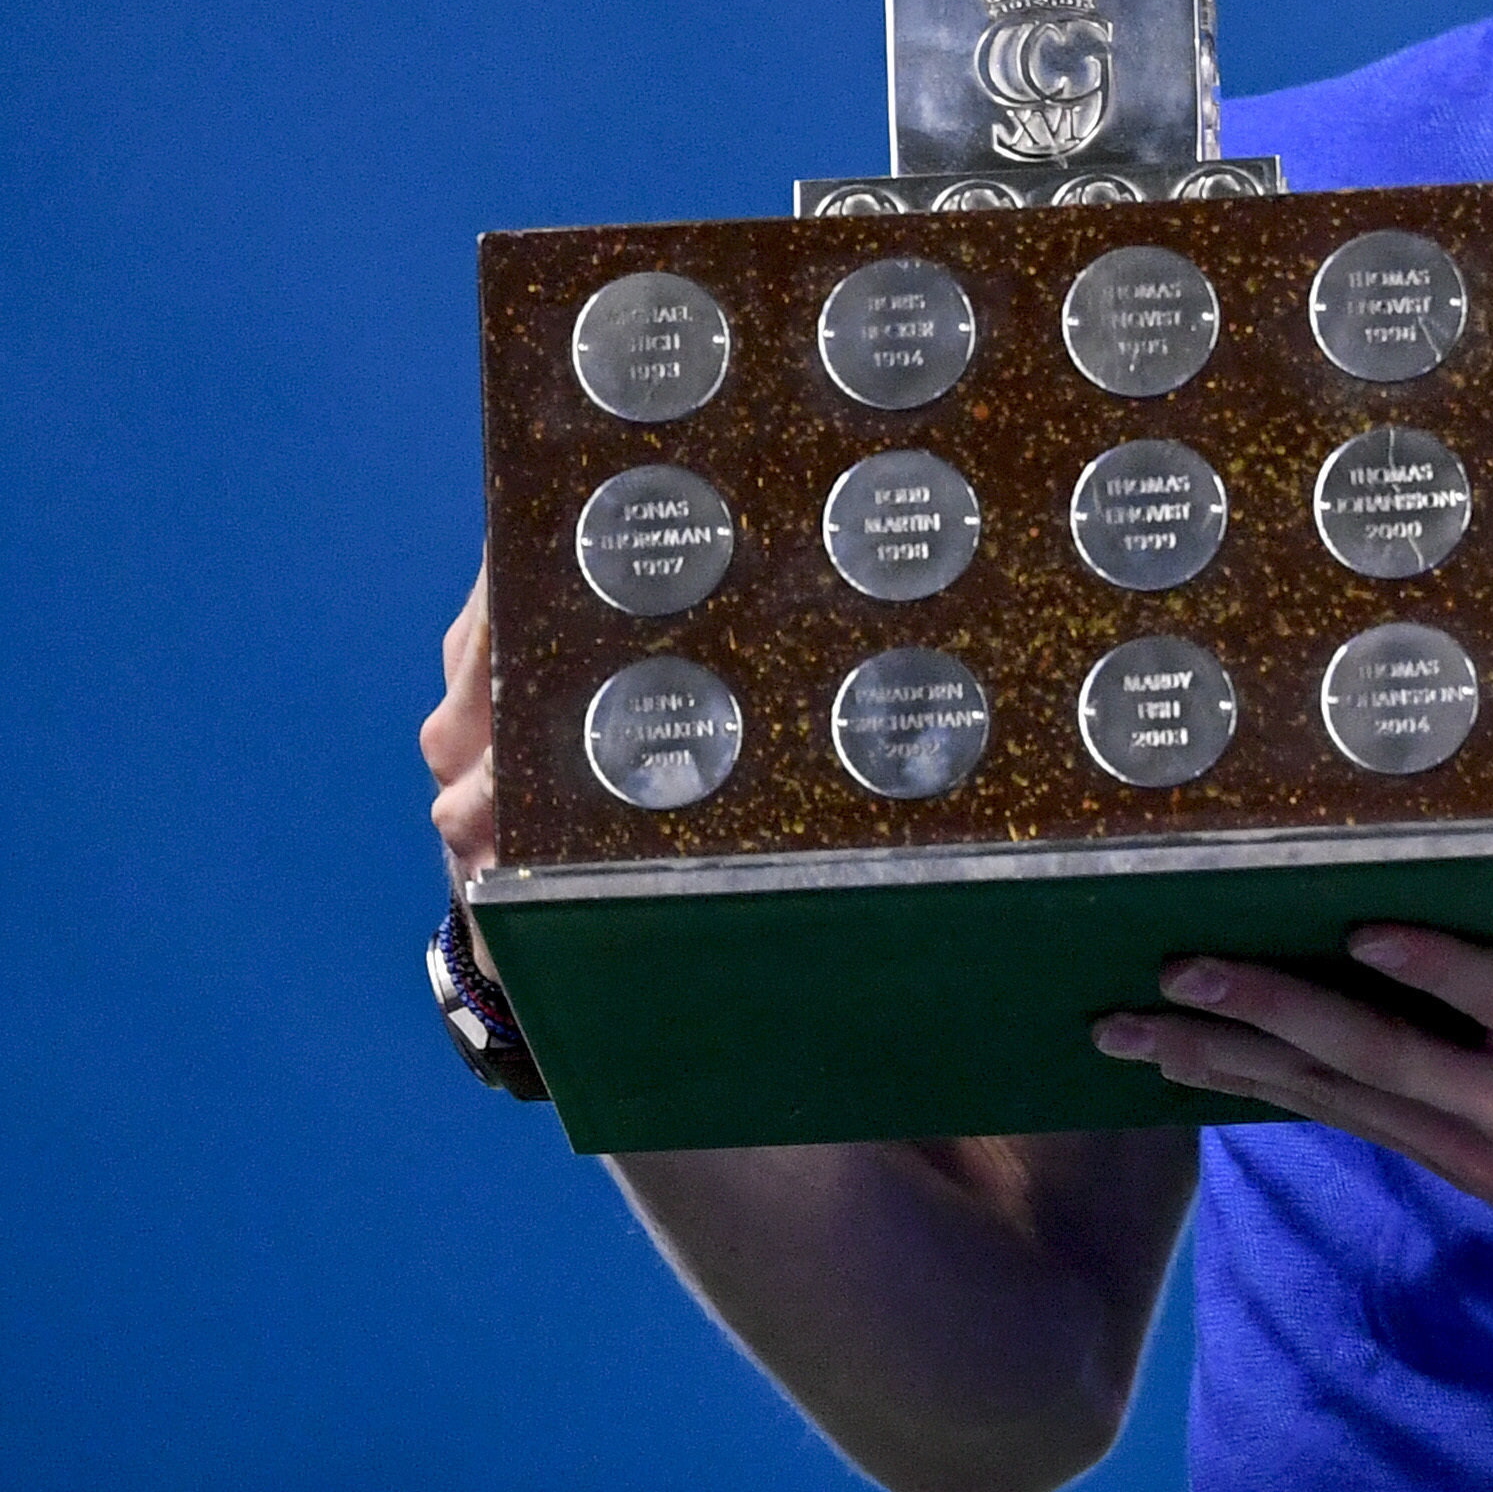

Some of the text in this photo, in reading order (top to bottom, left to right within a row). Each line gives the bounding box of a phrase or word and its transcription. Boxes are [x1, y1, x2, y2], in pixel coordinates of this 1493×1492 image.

[1005, 106, 1082, 148] XVI
[1101, 310, 1181, 328] NQVIST
[873, 349, 924, 367] 1994
[630, 362, 680, 380] 1993
[624, 501, 689, 521] JONAS
[1366, 521, 1423, 539] 2000
[1124, 532, 1177, 550] 1999
[633, 556, 684, 576] 1997
[1375, 715, 1430, 734] 2004
[1132, 728, 1188, 747] 2003
[642, 750, 690, 767] 2001
